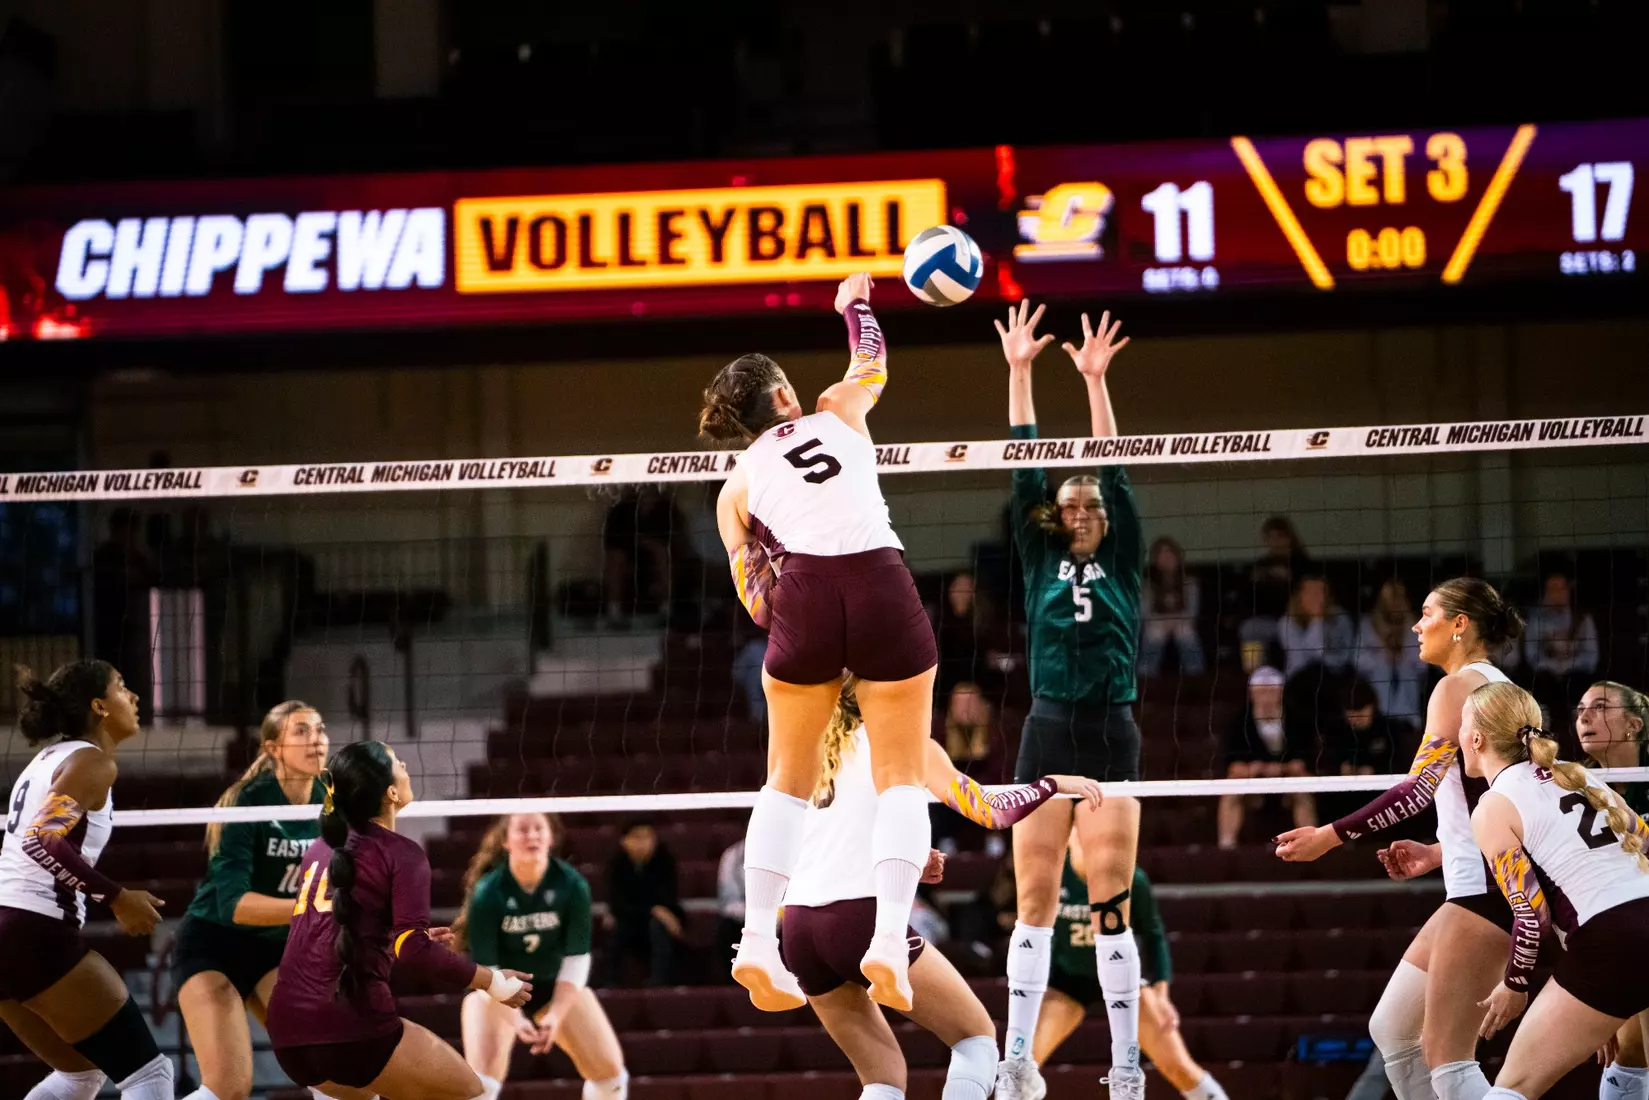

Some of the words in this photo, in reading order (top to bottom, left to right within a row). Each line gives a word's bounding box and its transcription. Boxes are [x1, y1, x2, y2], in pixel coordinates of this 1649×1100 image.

[1303, 135, 1413, 208] SET
[1427, 132, 1468, 202] 3
[1142, 180, 1215, 263] 11
[1559, 161, 1634, 242] 17
[55, 207, 445, 300] CHIPPEWA
[478, 198, 906, 273] VOLLEYBALL
[1347, 226, 1426, 270] 0:00
[1002, 440, 1075, 461] CENTRAL
[1080, 437, 1166, 459] MICHIGAN
[1171, 433, 1272, 455] VOLLEYBALL
[1365, 427, 1441, 447] CENTRAL
[1446, 422, 1534, 445] MICHIGAN
[1538, 417, 1645, 440] VOLLEYBALL
[14, 474, 100, 494] MICHIGAN
[103, 470, 202, 491] VOLLEYBALL
[293, 467, 365, 485] CENTRAL
[370, 463, 454, 483] MICHIGAN
[457, 459, 556, 480] VOLLEYBALL
[647, 454, 719, 474] CENTRAL
[782, 437, 842, 484] 5
[1072, 585, 1093, 622] 5
[7, 779, 31, 834] 9
[1366, 767, 1441, 832] CHIPPEWAS
[1559, 792, 1619, 849] 2
[522, 933, 541, 954] 7
[1508, 891, 1540, 971] CHIPPEWAS
